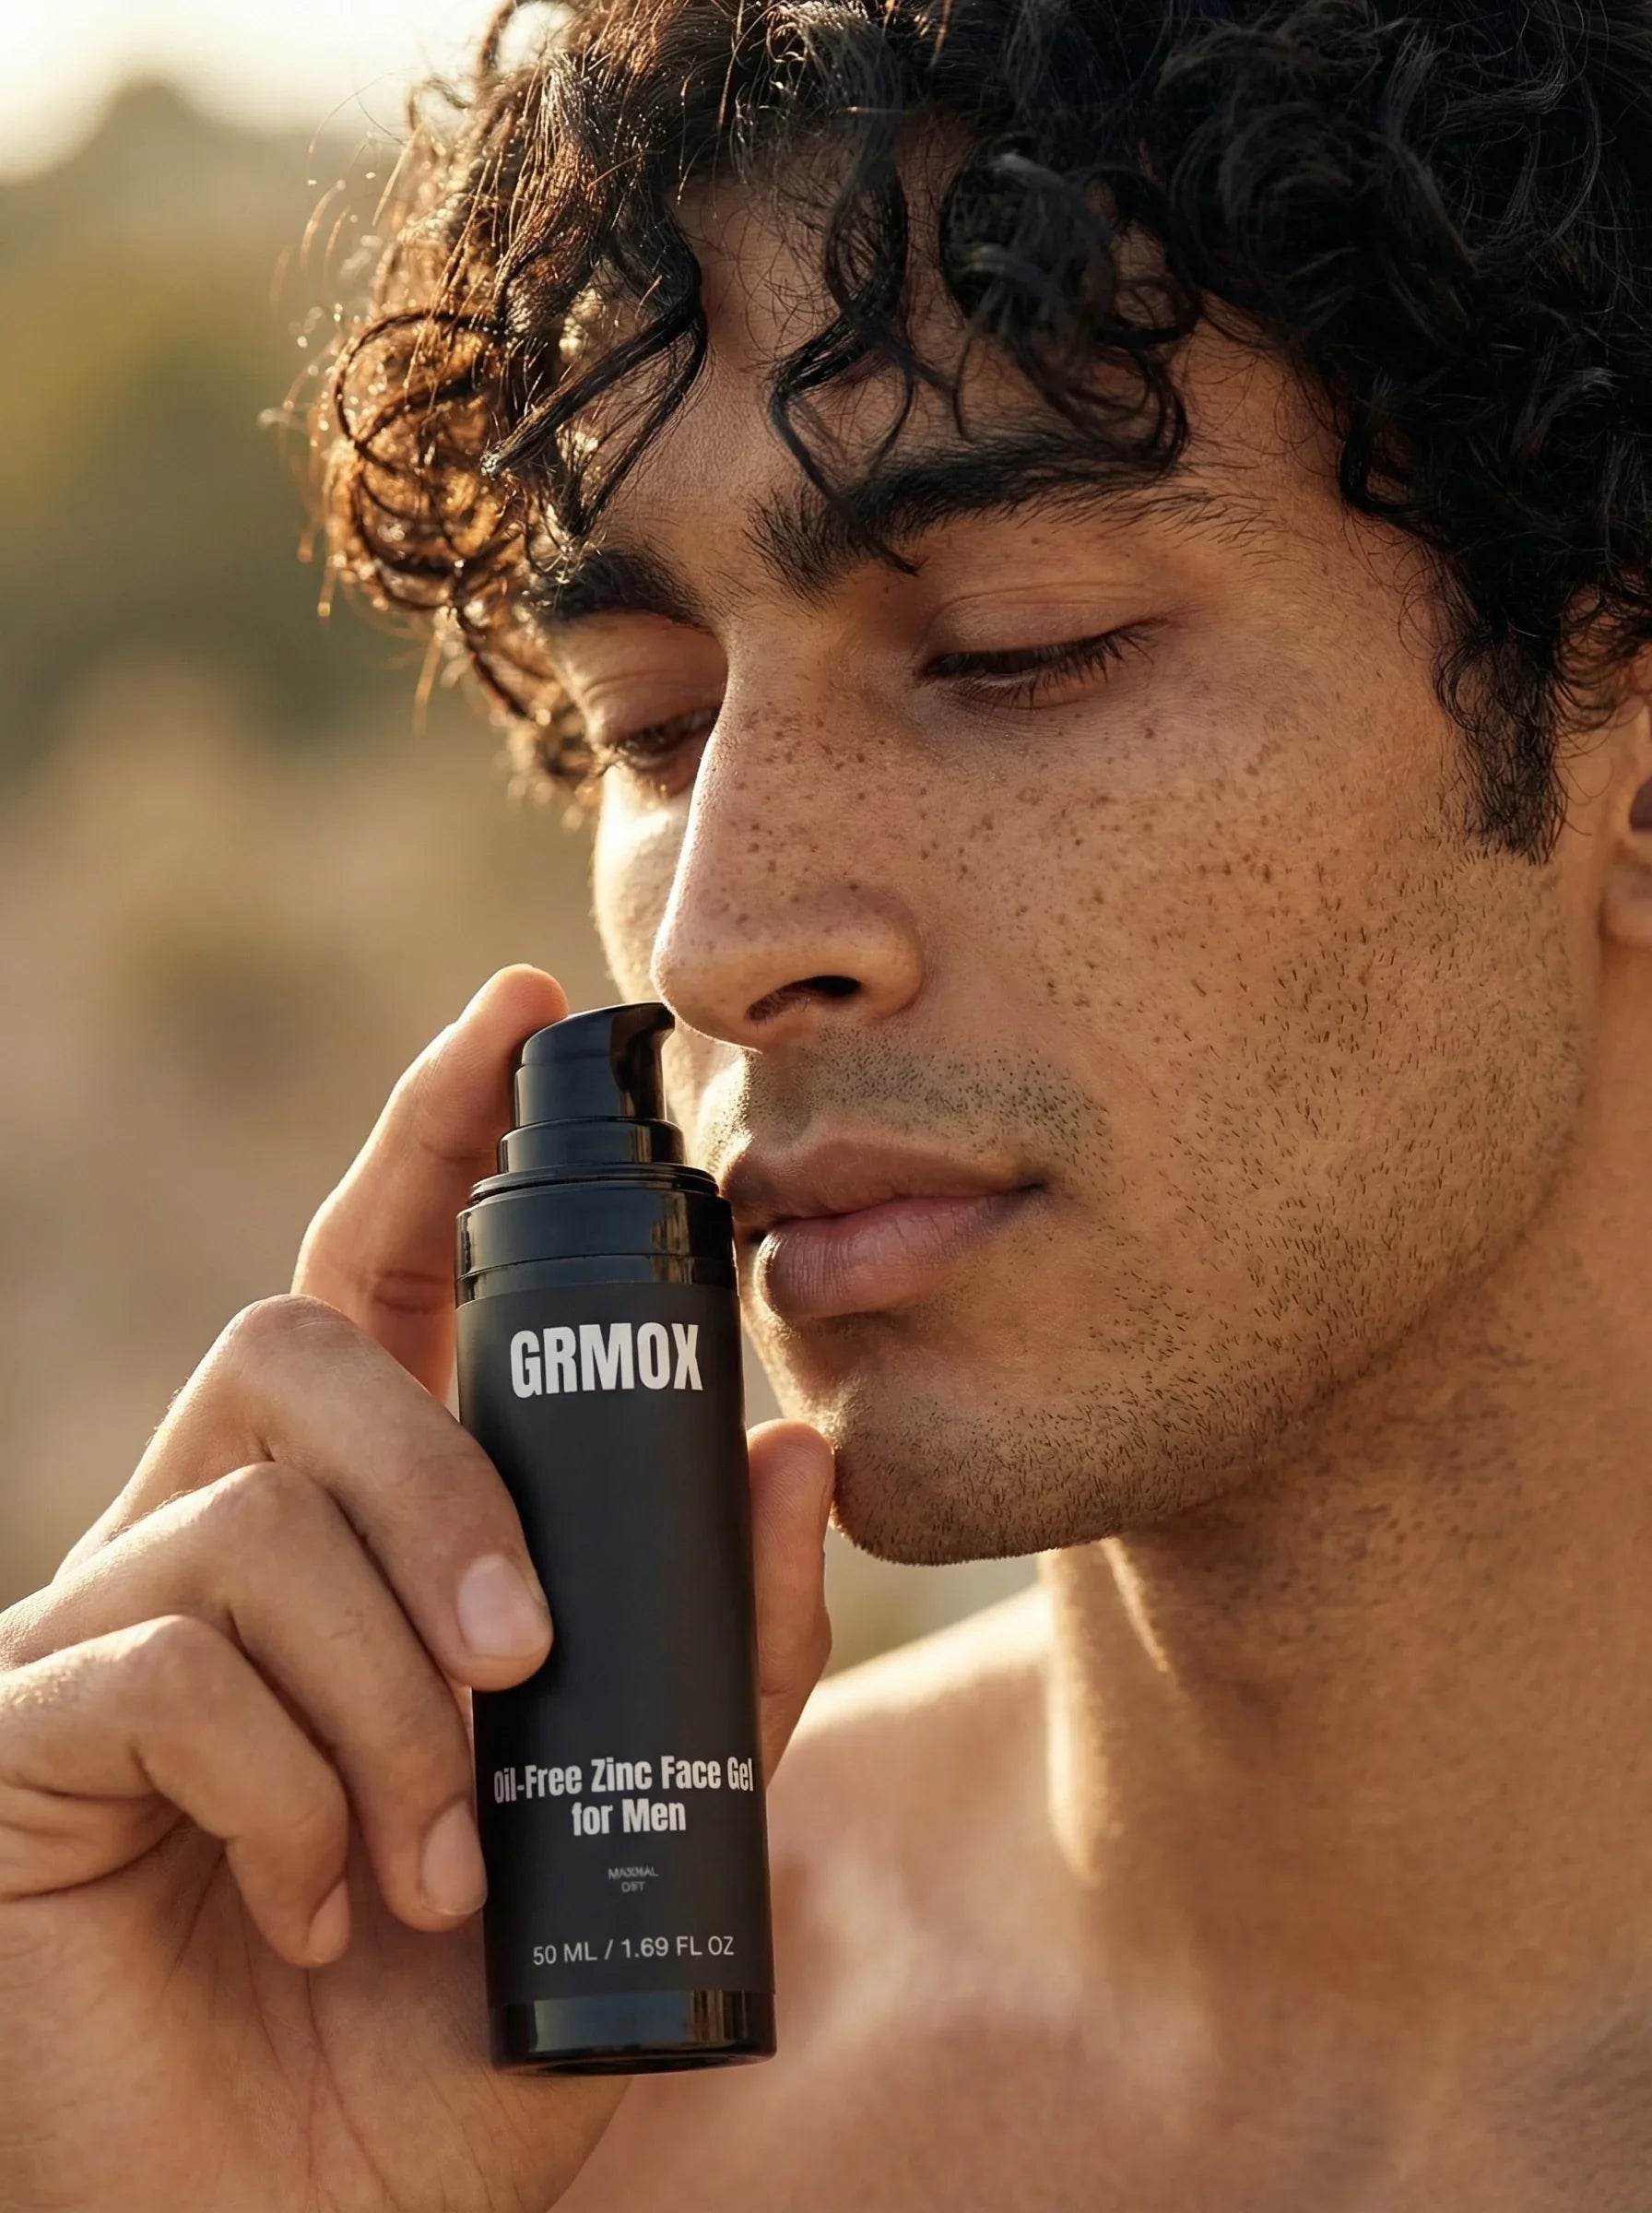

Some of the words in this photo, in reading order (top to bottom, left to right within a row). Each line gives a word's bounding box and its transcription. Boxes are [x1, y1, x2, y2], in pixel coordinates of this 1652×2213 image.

[510, 1322, 703, 1399] GRMOX
[494, 1765, 583, 1804] Oil-Free
[591, 1757, 653, 1793] Zinc
[660, 1756, 722, 1790] Face
[727, 1757, 754, 1792] Gel
[571, 1802, 613, 1837] for
[622, 1798, 687, 1833] Men
[533, 1945, 557, 1966] 50
[563, 1942, 598, 1962] ML
[604, 1939, 614, 1959] /
[620, 1937, 669, 1959] 1.69
[677, 1935, 702, 1956] FL
[707, 1935, 735, 1956] OZ
